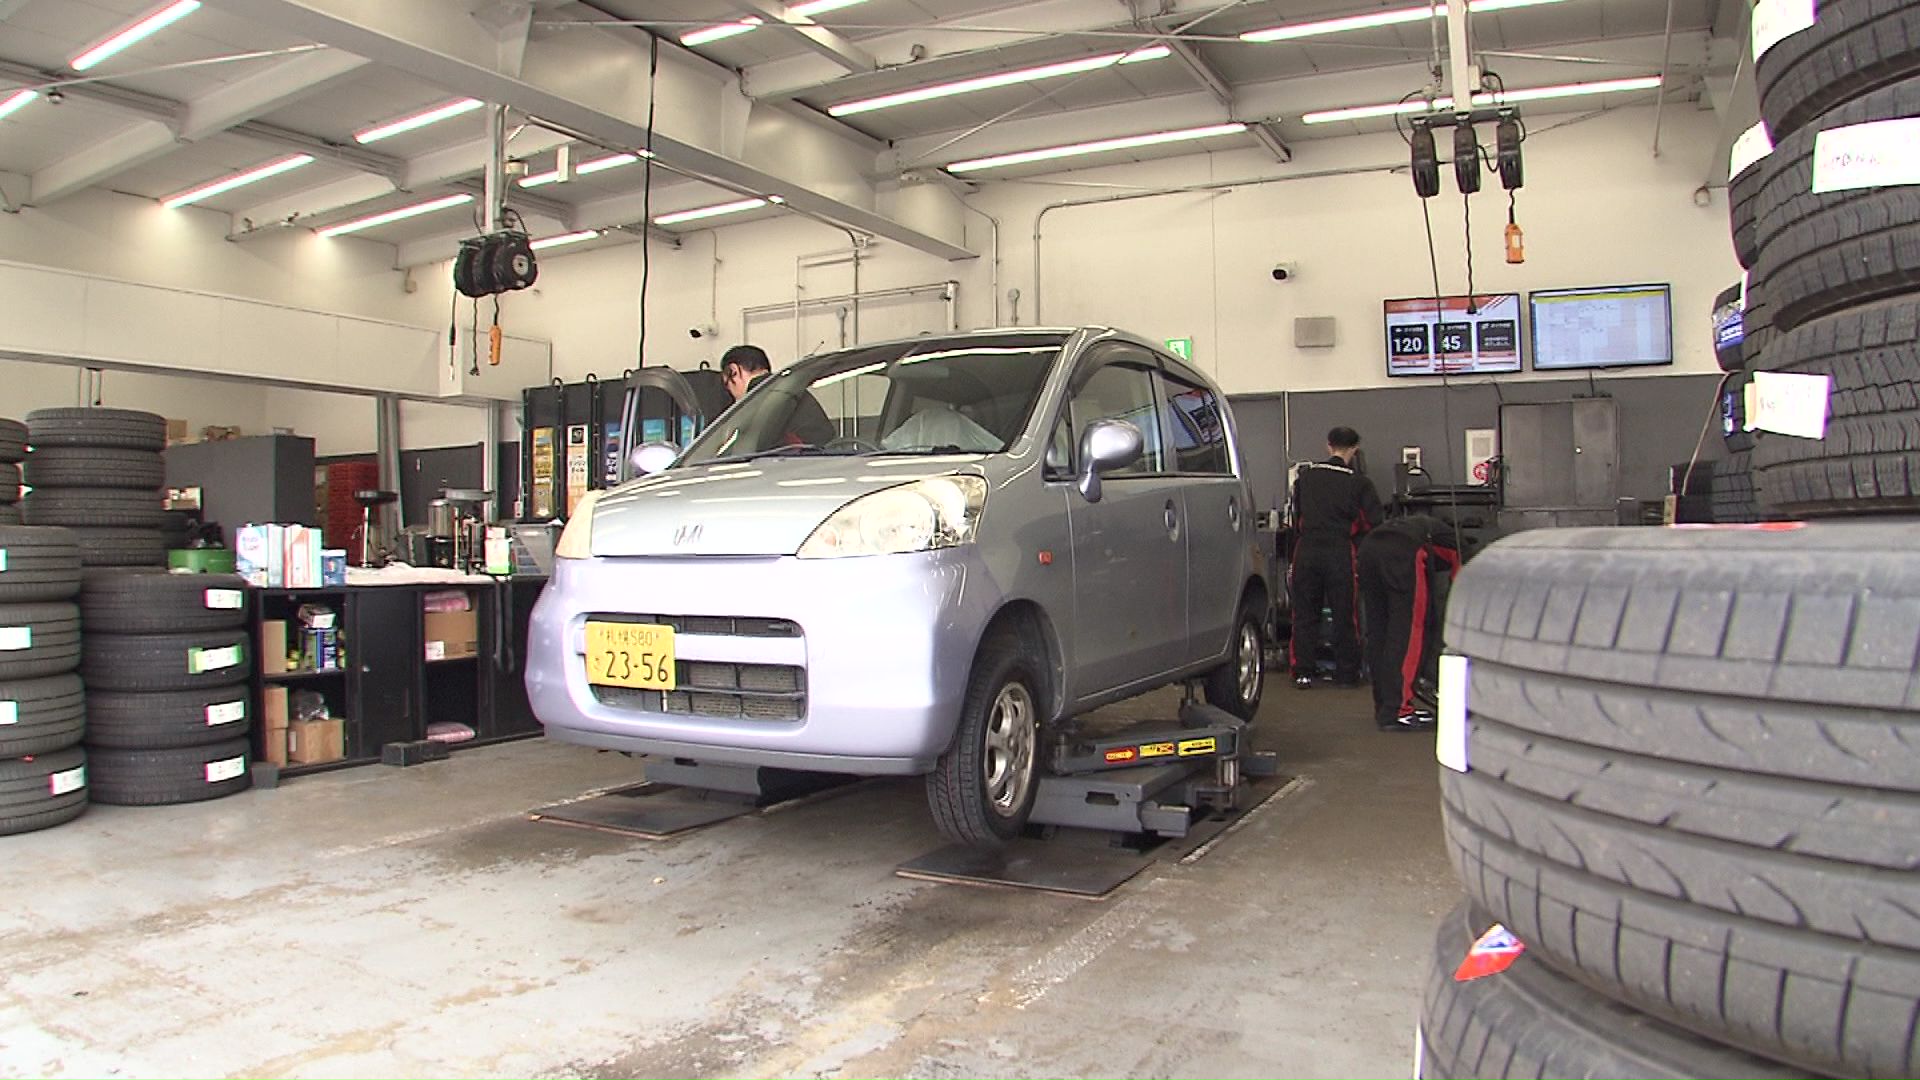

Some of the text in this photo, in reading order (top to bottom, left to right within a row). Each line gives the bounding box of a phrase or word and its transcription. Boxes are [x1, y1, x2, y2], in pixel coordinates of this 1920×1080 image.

[1393, 337, 1422, 353] 120
[1443, 335, 1461, 351] 45
[605, 650, 669, 683] 23-56
